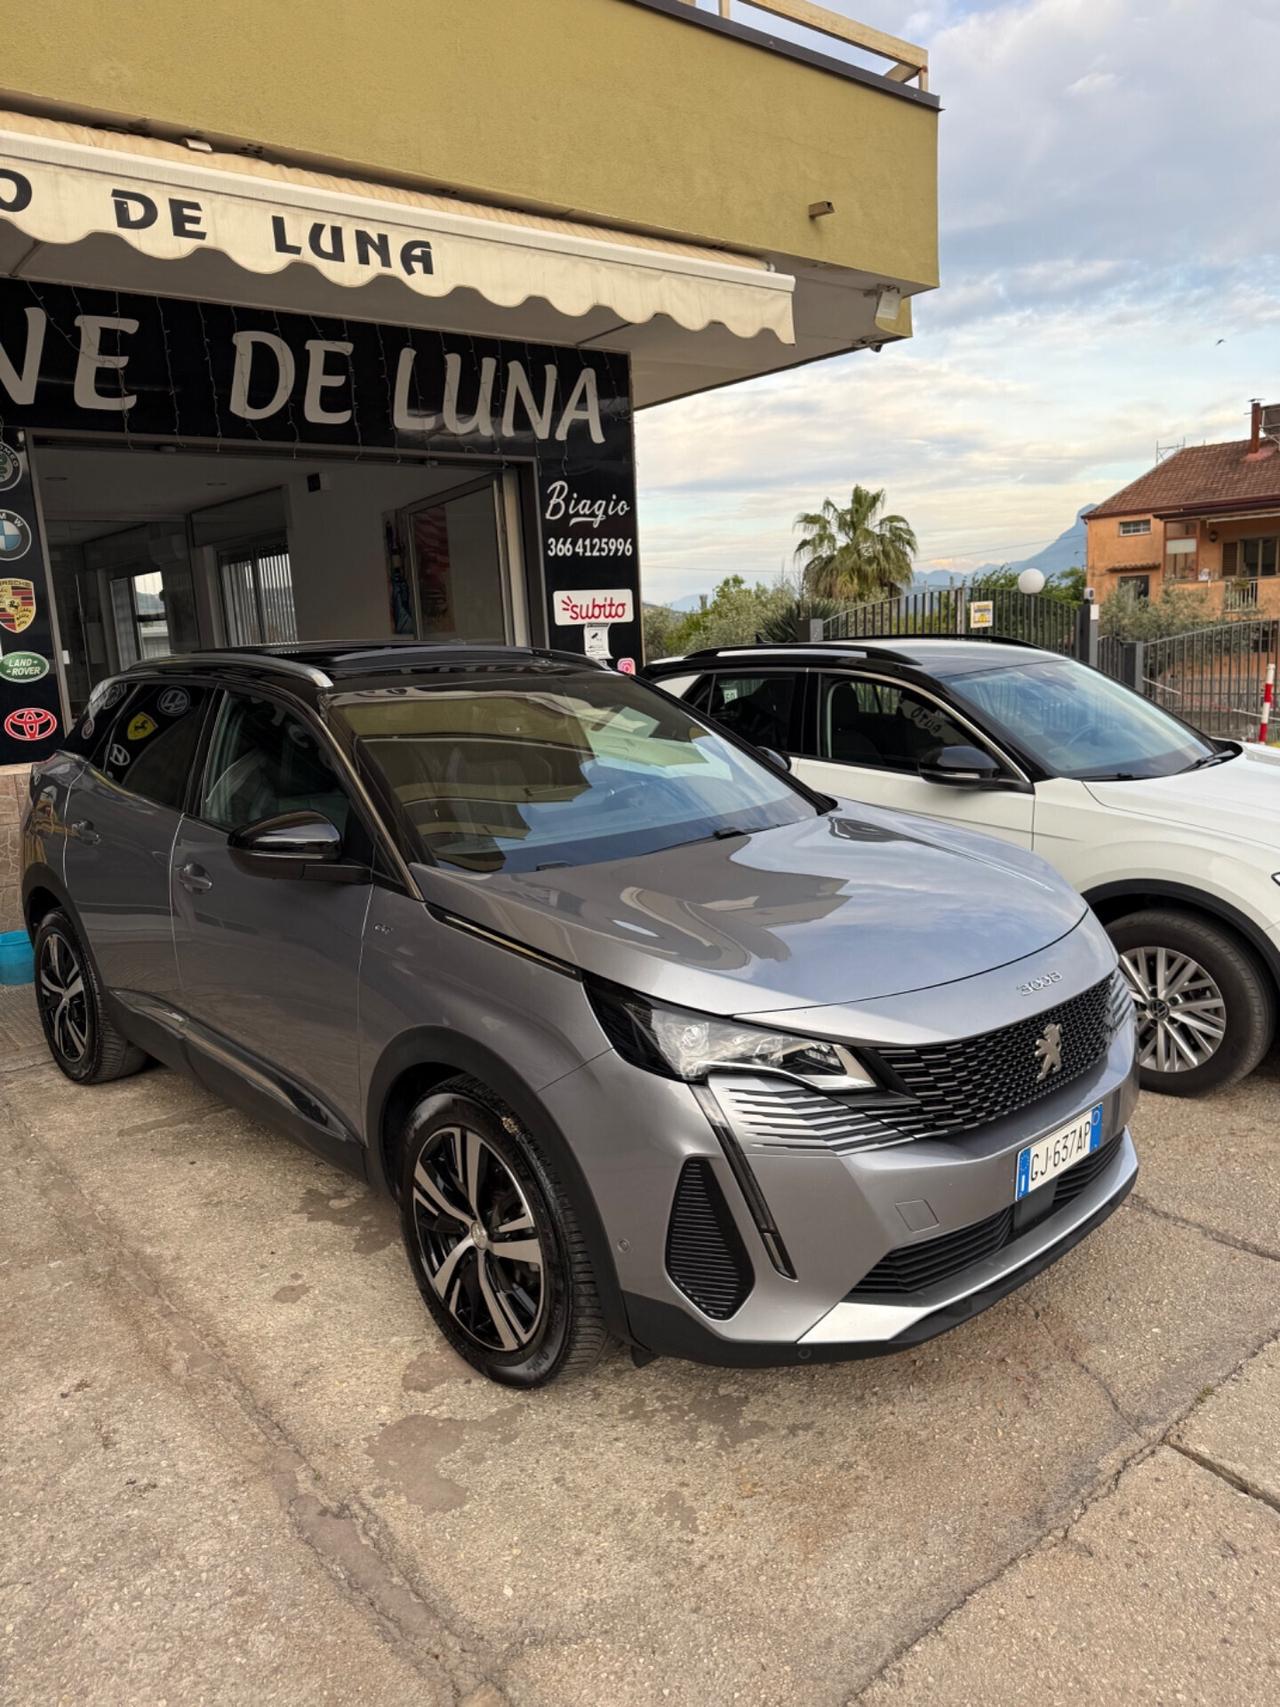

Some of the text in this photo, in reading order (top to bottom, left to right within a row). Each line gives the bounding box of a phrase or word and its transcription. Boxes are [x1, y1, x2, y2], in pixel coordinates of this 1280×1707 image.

[111, 188, 208, 241] DE
[271, 215, 435, 277] LUNA
[0, 306, 605, 444] NE DE LUNA
[545, 480, 630, 528] Biagio
[569, 596, 626, 620] subito
